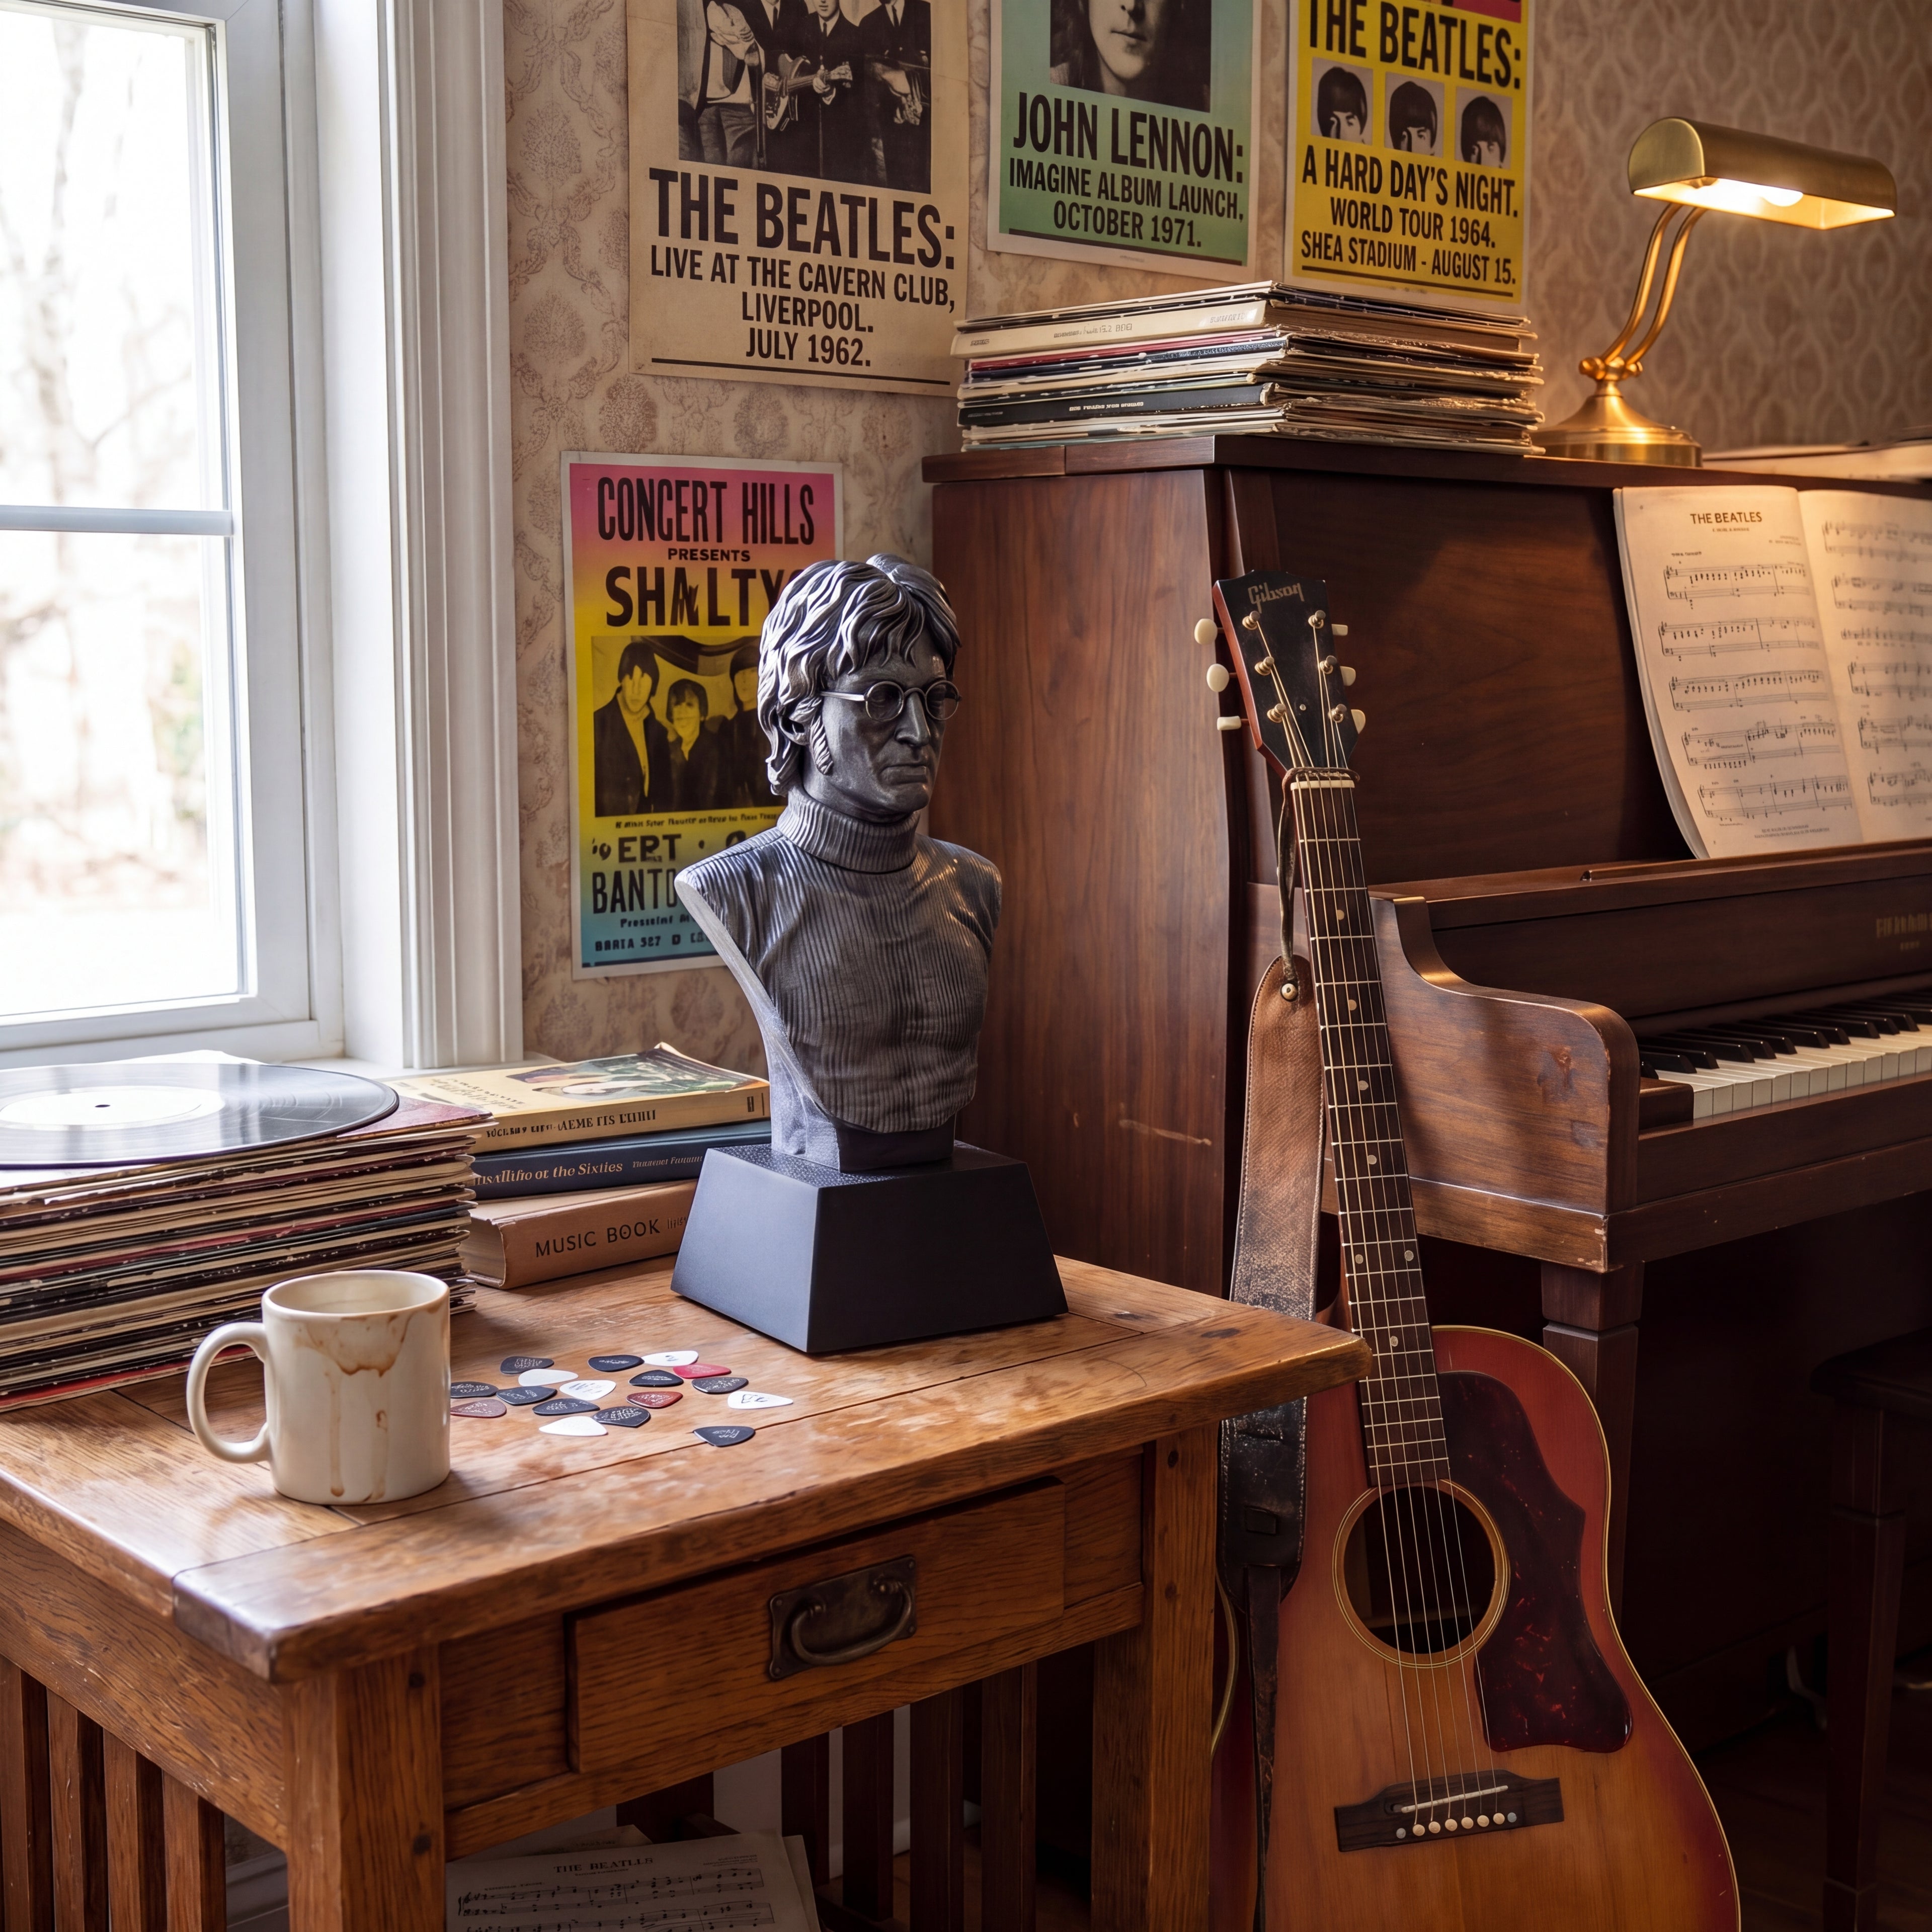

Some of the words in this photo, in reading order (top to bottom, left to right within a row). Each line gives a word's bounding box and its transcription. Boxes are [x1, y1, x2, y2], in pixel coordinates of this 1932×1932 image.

[1380, 1, 1521, 90] BEATLES:
[1013, 92, 1098, 160] JOHN
[1111, 108, 1243, 183] LENNON:
[1009, 157, 1091, 197] IMAGINE
[1097, 172, 1162, 208] ALBUM
[1302, 144, 1318, 185] A
[1325, 148, 1383, 195] HARD
[1390, 159, 1448, 206] DAY'S
[1456, 171, 1518, 218] NIGHT.
[649, 167, 739, 245] THE
[756, 182, 955, 270] BEATLES:
[1054, 200, 1144, 240] OCTOBER
[1151, 215, 1201, 248] 1971.
[1330, 196, 1393, 233] WORLD
[1399, 207, 1444, 242] TOUR
[1450, 216, 1496, 249] 1964.
[651, 245, 703, 281] LIVE
[710, 253, 740, 284] AT
[747, 256, 791, 290] THE
[798, 262, 886, 300] CAVERN
[894, 273, 955, 313] CLUB,
[1301, 229, 1343, 262] SHEA
[1348, 236, 1417, 272] STADIUM
[1431, 249, 1490, 282] AUGUST
[1494, 258, 1516, 285] 15.
[742, 291, 873, 333] LIVERPOOL.
[746, 327, 799, 361] JULY
[808, 334, 871, 367] 1962.
[597, 476, 728, 543] CONCERT
[742, 482, 815, 545] HILLS
[1689, 513, 1713, 524] THE
[1714, 511, 1762, 523] BEATLES
[668, 547, 751, 562] PRESENTS
[1247, 582, 1305, 614] Gibson
[553, 1166, 575, 1178] the
[578, 1161, 623, 1175] Sixties
[535, 1231, 597, 1258] MUSIC
[607, 1219, 661, 1244] BOOK
